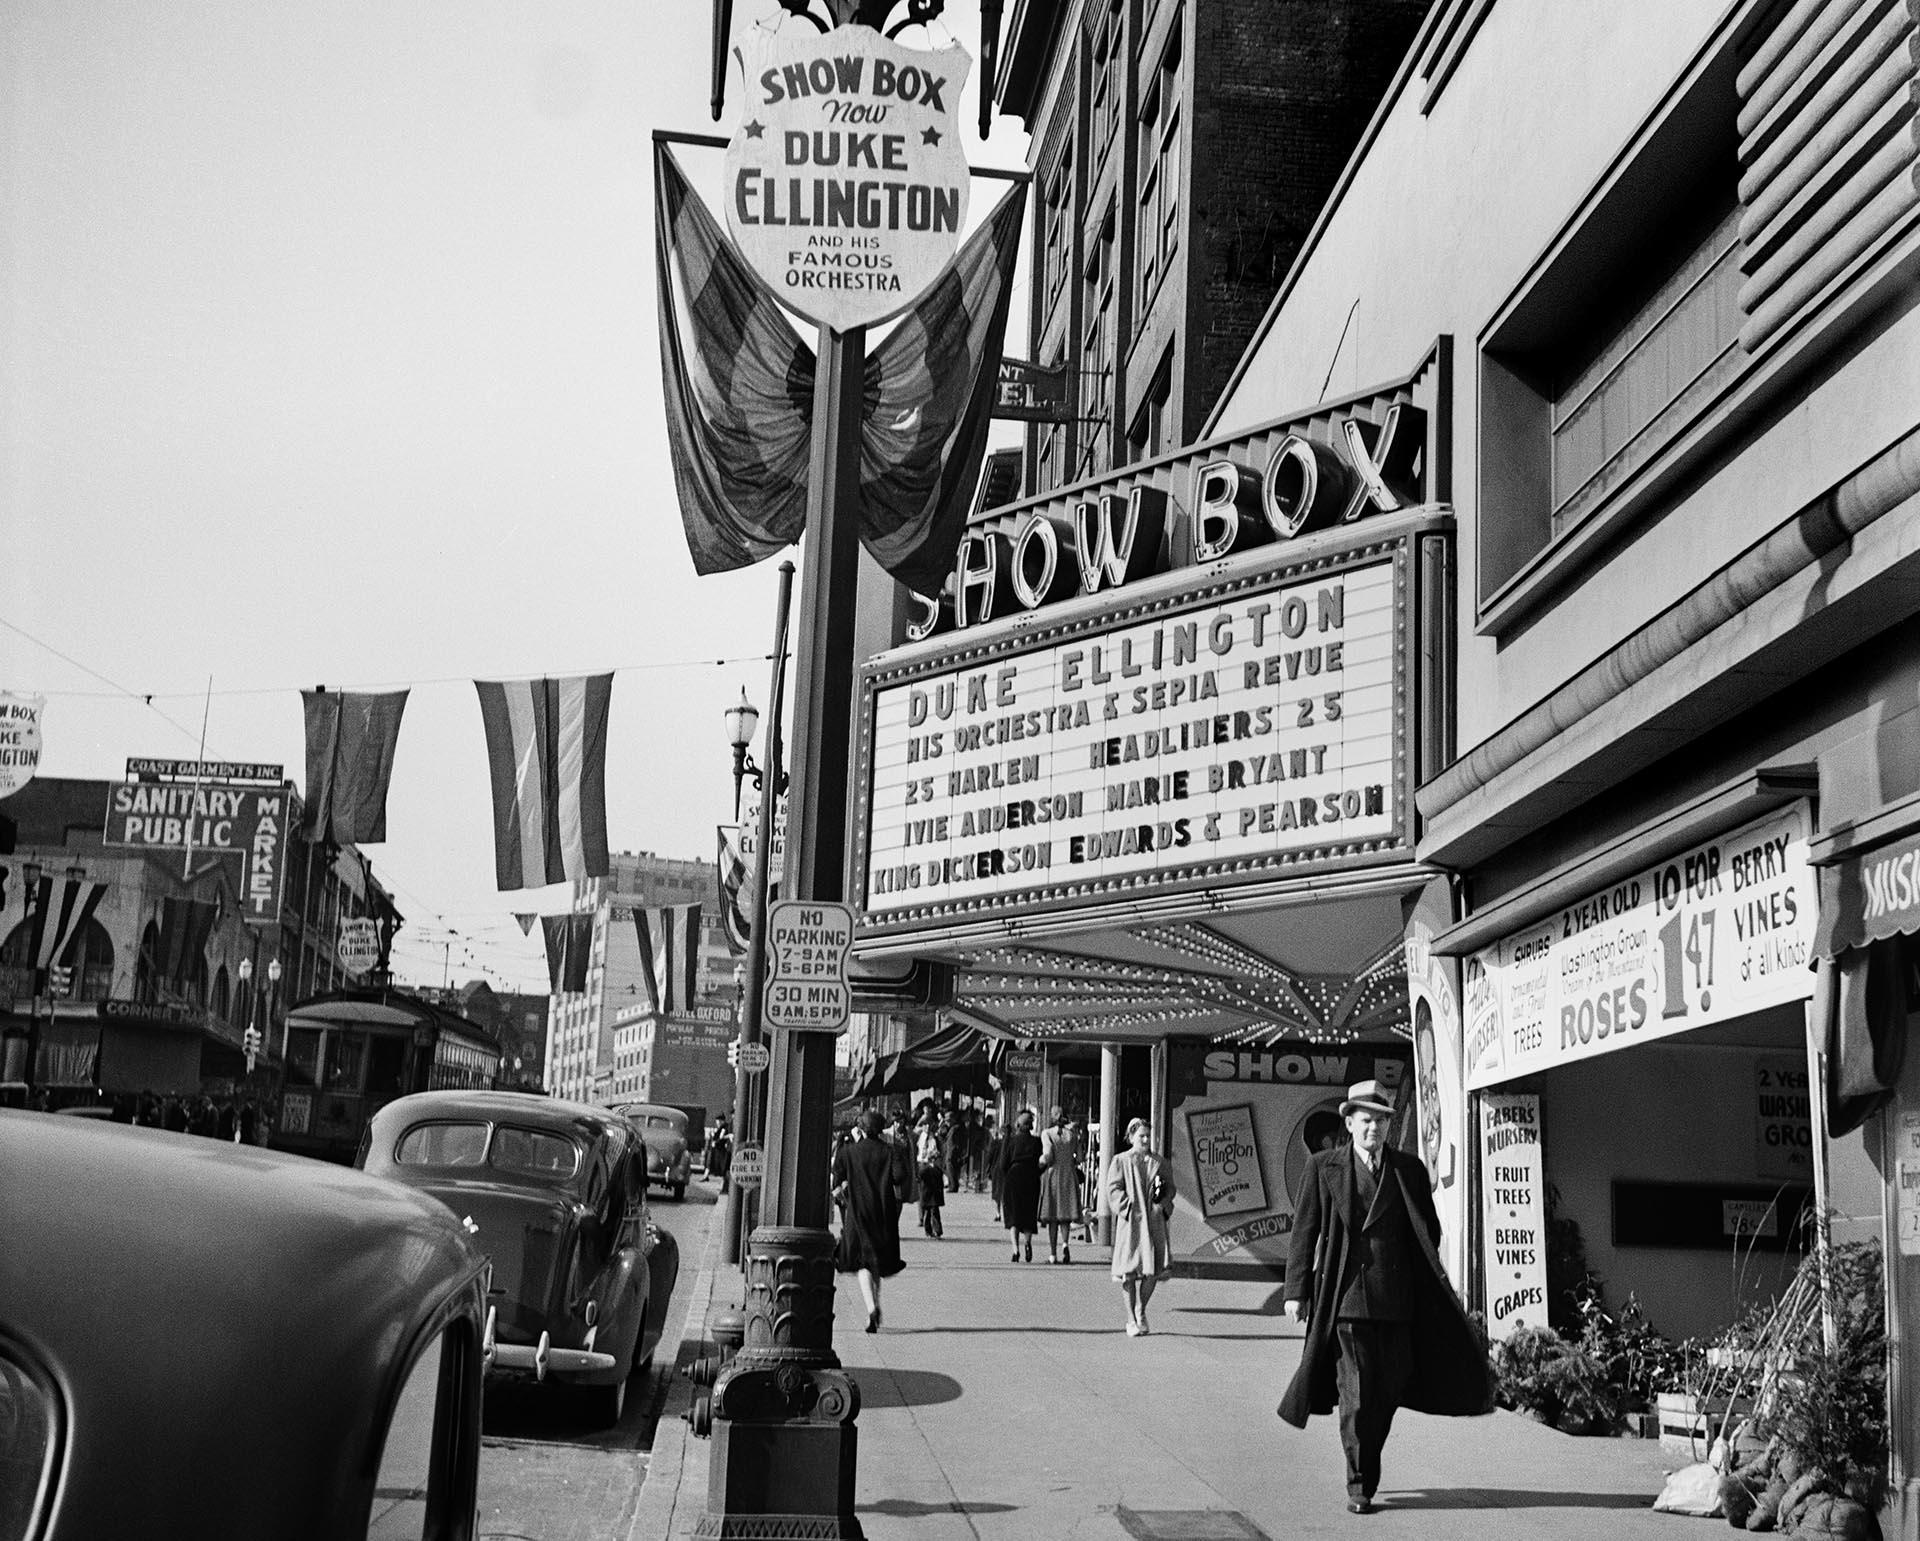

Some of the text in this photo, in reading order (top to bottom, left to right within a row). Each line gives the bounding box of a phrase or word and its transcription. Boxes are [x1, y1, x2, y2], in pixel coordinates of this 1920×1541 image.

[760, 54, 946, 114] SHOW BOX
[784, 131, 908, 171] DUKE
[735, 168, 959, 233] ELLINGTON
[807, 235, 880, 249] AND HIS
[788, 251, 893, 269] FAMOUS
[785, 269, 901, 291] ORCHESTRA
[906, 404, 1408, 641] SHOW BOX
[909, 585, 1344, 728] DUKE ELLINGTON
[11, 704, 37, 722] BOX
[907, 641, 1344, 764] HIS ORCHESTRA & SEPIA REVUE
[905, 691, 1342, 806] 25 HARLEM HEADLINERS 25
[128, 760, 174, 774] COAST
[178, 761, 254, 777] GARMENTS
[904, 744, 1328, 847] IVIE ANDERSON MARIE BRYANT
[124, 816, 232, 847] PUBLIC
[873, 784, 1385, 895] KING DICKERSON EDWARDS & PEARSON
[115, 786, 281, 914] SANITARY MARKET
[1684, 845, 1723, 905] FOR
[1731, 832, 1790, 893] BERRY
[1863, 848, 1920, 920] MUSI
[800, 910, 823, 926] NO
[1562, 881, 1641, 938] 2 YEAR OLD
[1733, 885, 1798, 942] VINES
[776, 928, 846, 946] PARKING
[1514, 935, 1551, 970] SHRUBS
[1561, 938, 1615, 977] Washington
[1617, 928, 1648, 954] Grown
[1740, 945, 1753, 982] of
[1759, 937, 1773, 976] all
[775, 986, 839, 1003] 30 MIN
[697, 1006, 732, 1022] OXFORD
[1561, 978, 1648, 1051] ROSES
[1513, 1020, 1543, 1056] TREES
[1203, 1051, 1349, 1082] SHOW
[1758, 1069, 1771, 1088] 2
[1487, 1102, 1535, 1130] FABER'S
[1487, 1127, 1538, 1156] NURSERY
[1765, 1124, 1813, 1147] GRO
[744, 1151, 757, 1161] NO
[1196, 1134, 1254, 1176] Ellington
[735, 1175, 762, 1183] PARKIN
[1495, 1166, 1530, 1183] FRUIT
[1208, 1182, 1251, 1206] ORCHESTRA
[1494, 1188, 1531, 1205] TREES
[1212, 1215, 1288, 1255] FLOOR SHOW
[1495, 1228, 1535, 1245] BERRY
[1495, 1249, 1536, 1266] VINES
[1493, 1286, 1543, 1321] GRAPES
